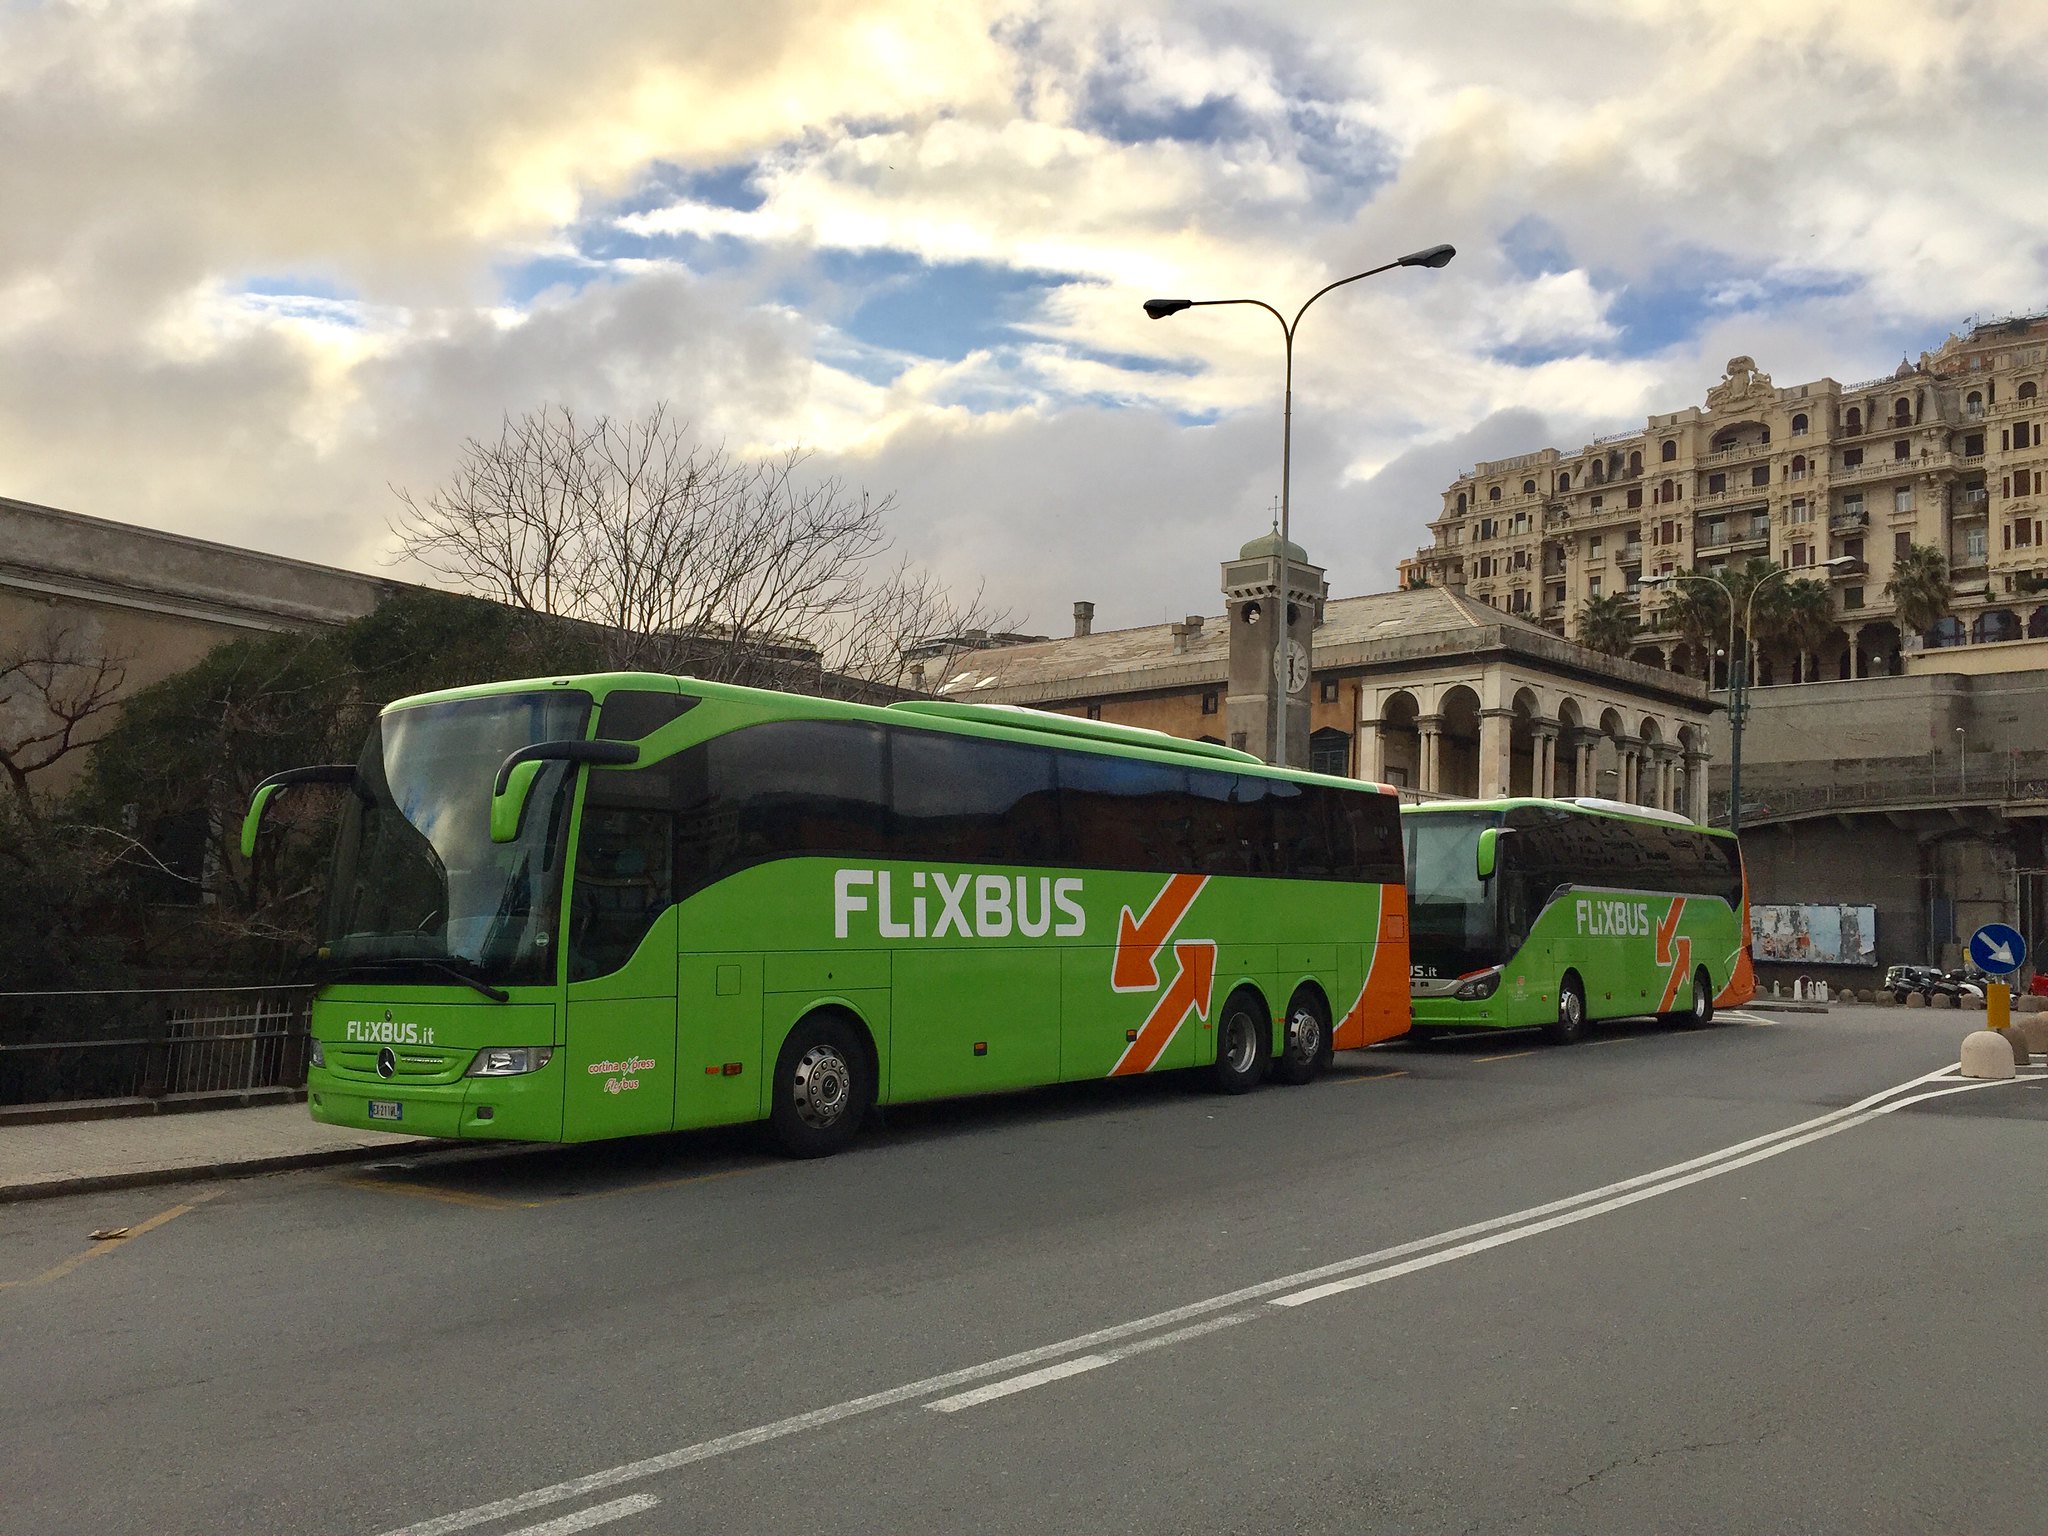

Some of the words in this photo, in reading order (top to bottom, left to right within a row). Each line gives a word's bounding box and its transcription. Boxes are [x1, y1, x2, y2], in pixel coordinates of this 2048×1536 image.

[834, 868, 1086, 939] FLiXBUS
[1576, 899, 1650, 937] FLiXBUS
[347, 1021, 434, 1044] FLiXBUS.it
[588, 1060, 619, 1074] cortina
